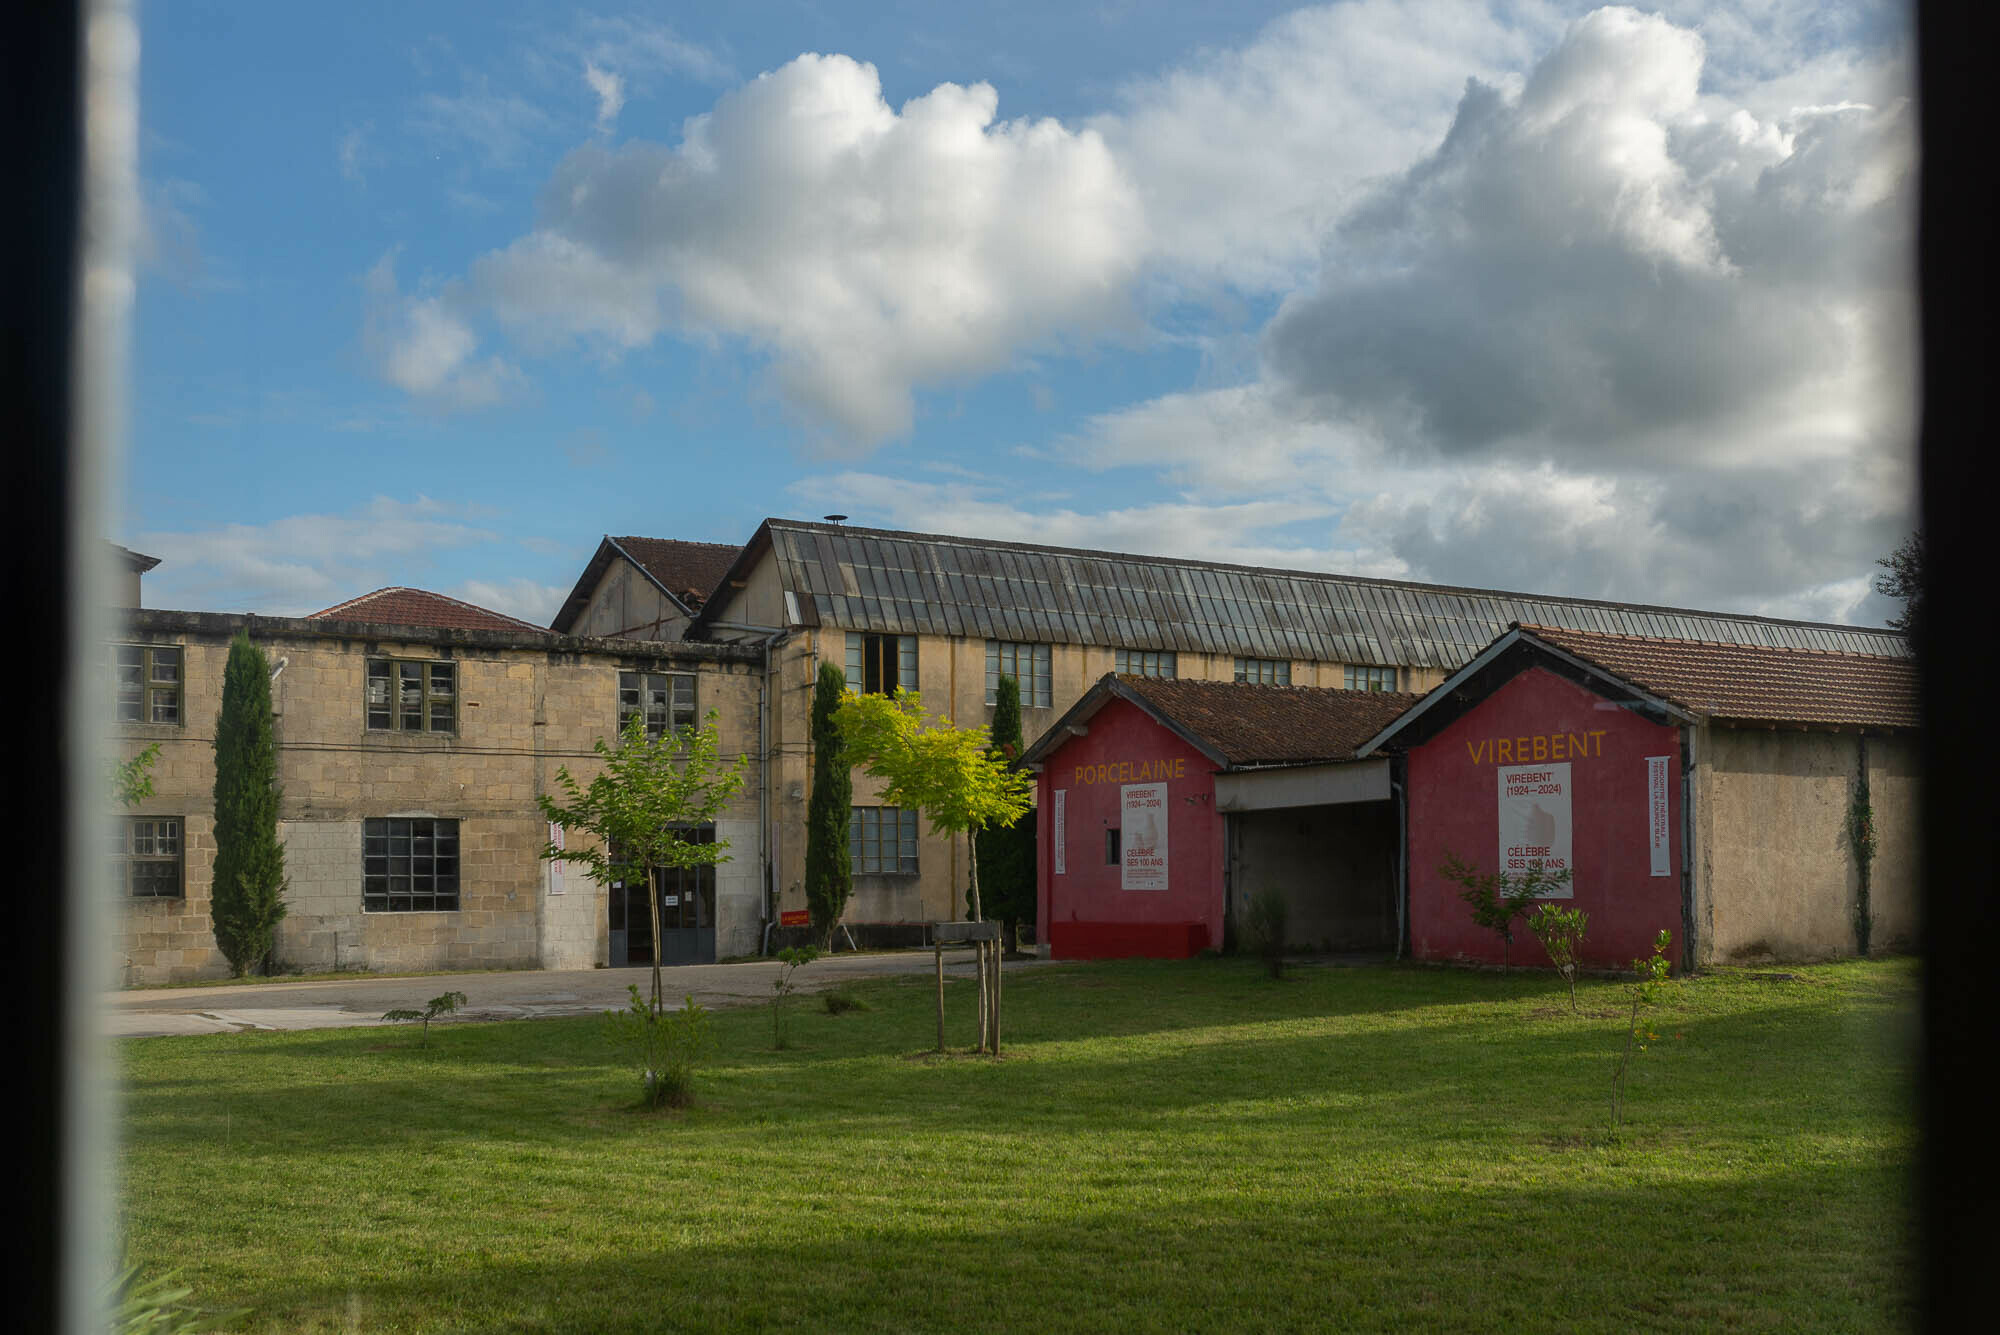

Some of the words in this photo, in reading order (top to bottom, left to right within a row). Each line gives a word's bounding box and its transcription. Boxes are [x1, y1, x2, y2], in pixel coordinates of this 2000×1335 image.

[1466, 731, 1607, 765] VIREBENT
[1075, 758, 1185, 785] PORCELAINE
[1506, 772, 1552, 785] VIREBENT
[1126, 789, 1158, 799] VIREBENT
[1508, 844, 1551, 857] CÉLÈBRE
[1151, 857, 1163, 867] ANS
[1507, 858, 1526, 869] SES
[1545, 858, 1565, 869] ANS
